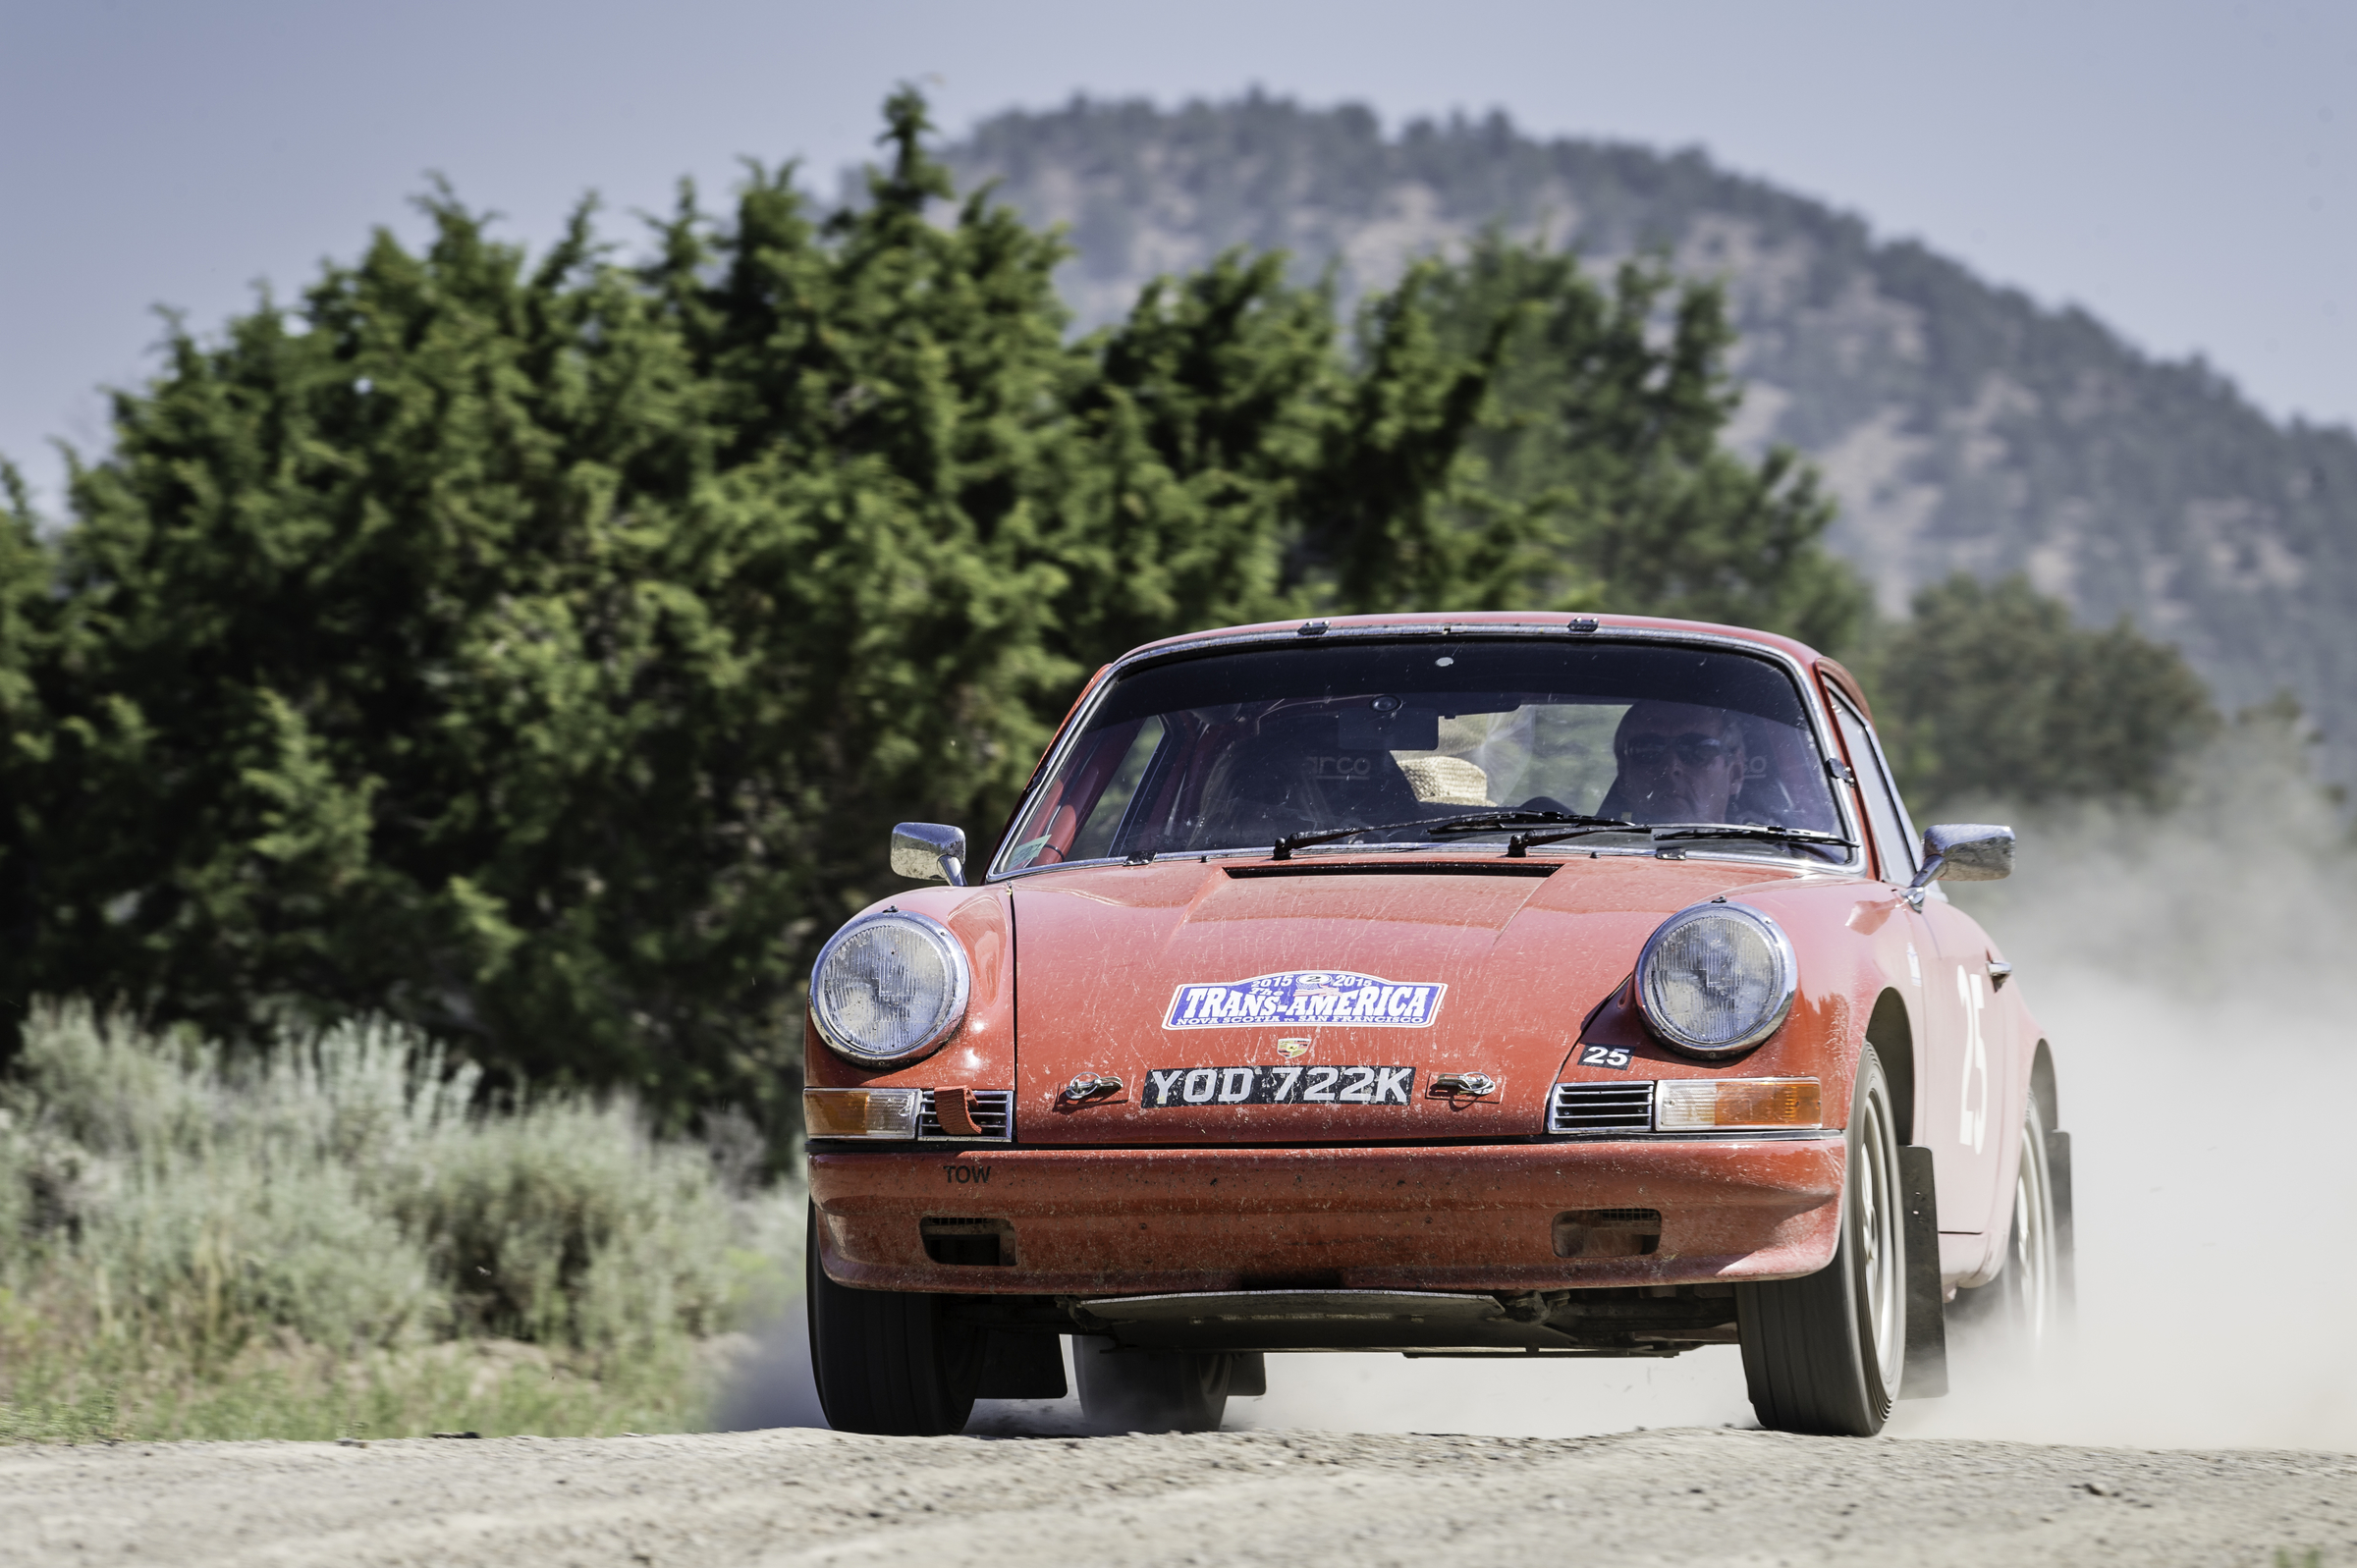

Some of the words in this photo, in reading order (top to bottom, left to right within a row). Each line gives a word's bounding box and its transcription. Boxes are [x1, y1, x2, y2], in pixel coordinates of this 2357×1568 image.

[1304, 756, 1371, 775] arco
[1250, 975, 1294, 988] 2015
[1331, 974, 1373, 987] 2015
[1248, 987, 1284, 997] The
[1182, 986, 1430, 1018] TRANS-AMERICA
[1177, 1017, 1219, 1026] NOVA
[1222, 1015, 1280, 1024] SCOTIA
[1582, 1046, 1630, 1066] 25
[1956, 964, 1988, 1156] 25
[1152, 1068, 1254, 1105] YOD
[1272, 1066, 1412, 1104] 722K
[943, 1165, 991, 1184] TOW
